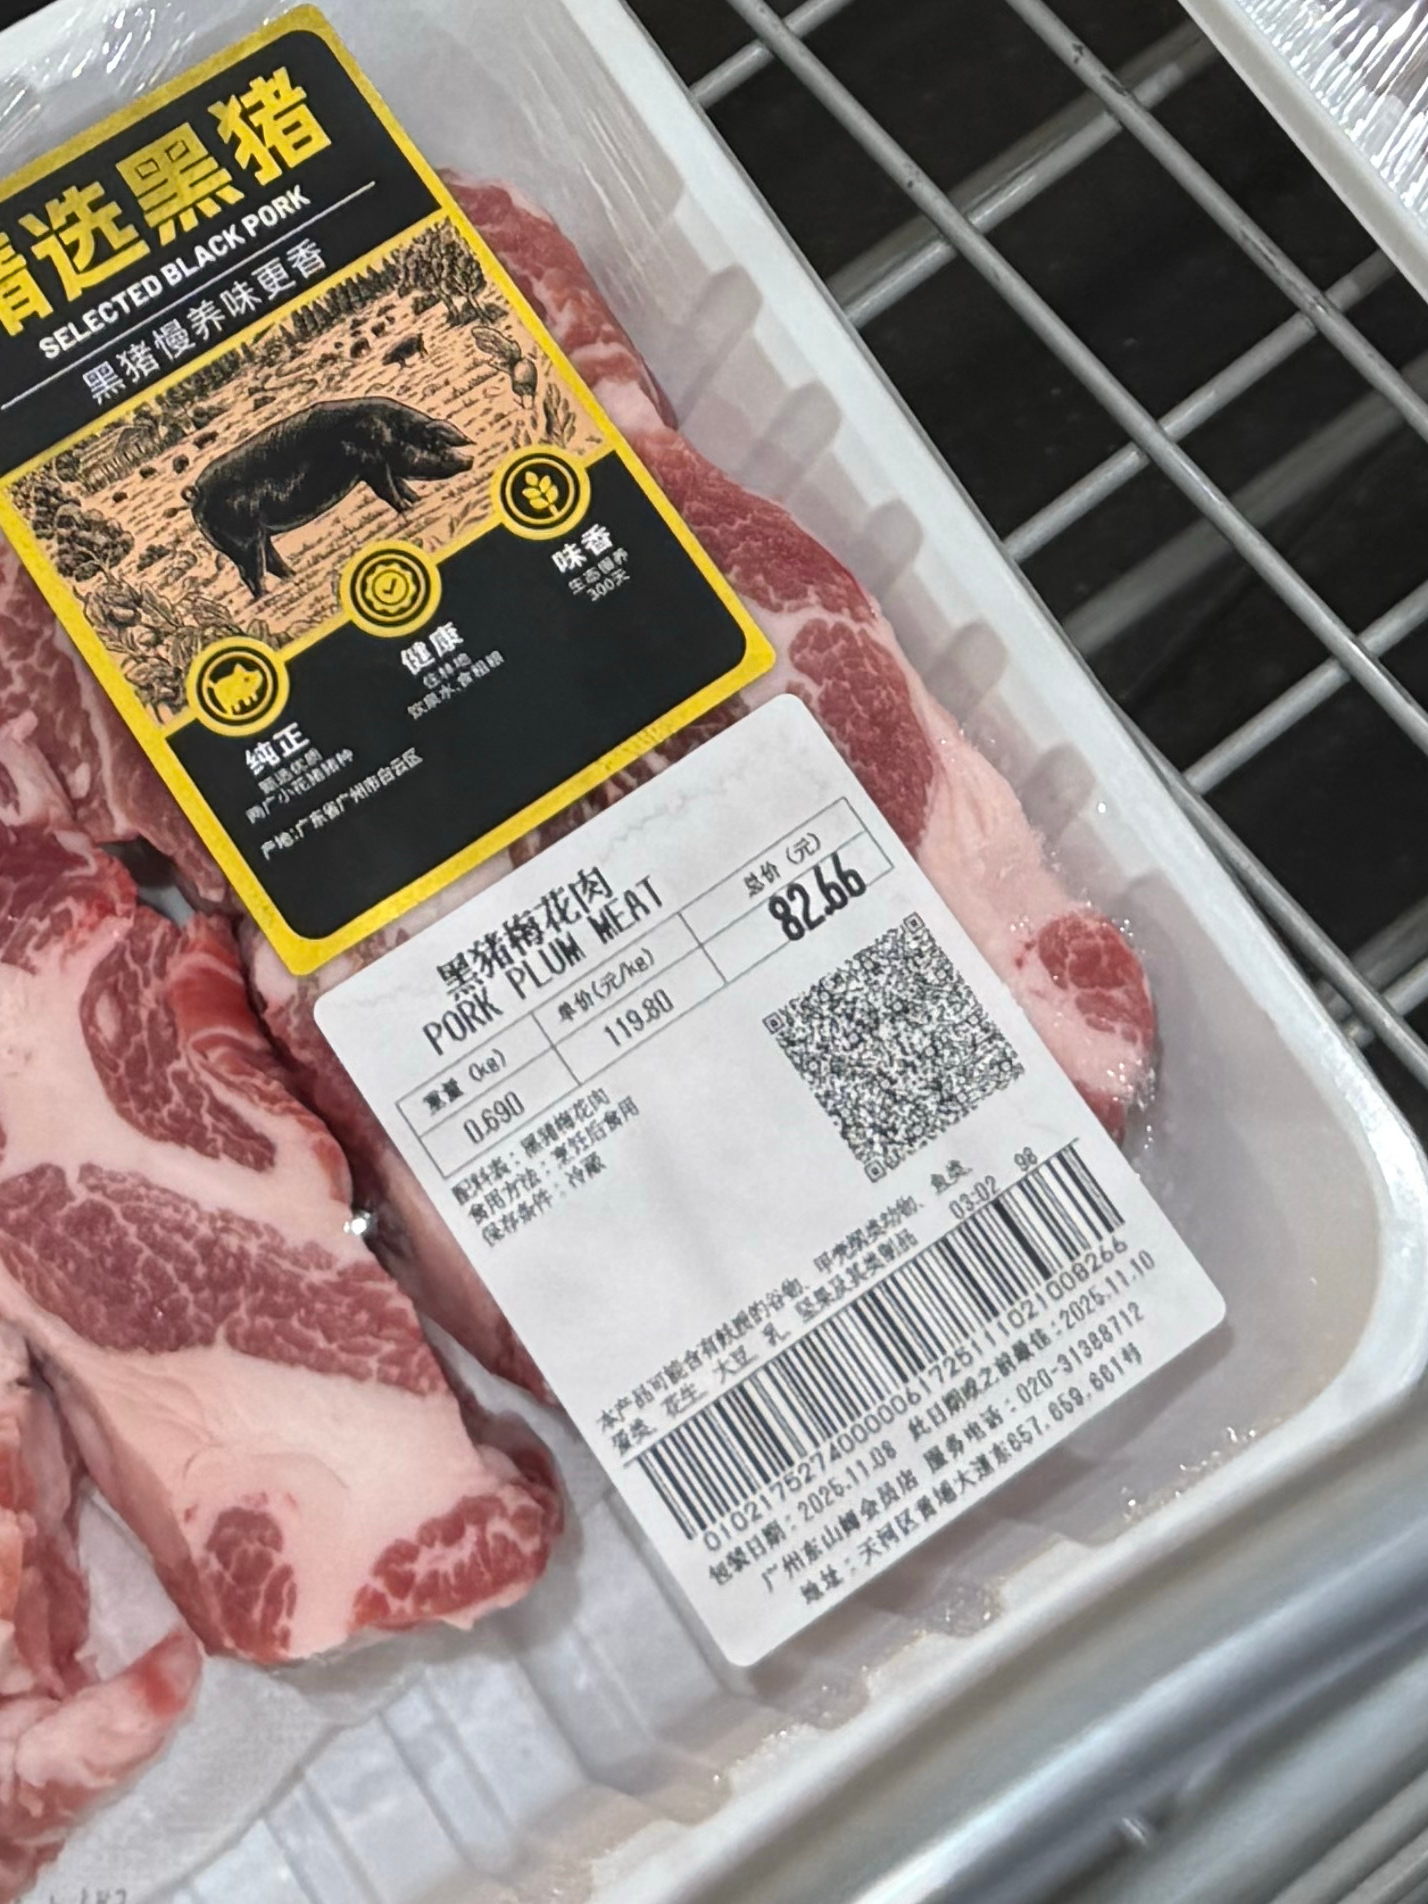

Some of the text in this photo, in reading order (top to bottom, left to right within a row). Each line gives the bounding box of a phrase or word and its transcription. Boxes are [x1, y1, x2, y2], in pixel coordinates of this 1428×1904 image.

[38, 183, 311, 359] SELECTED BLACK PORK
[81, 237, 326, 405] 黑猪慢养味更香
[550, 522, 613, 573] 味香
[585, 567, 630, 602] 300天
[399, 620, 464, 675] 健康
[244, 721, 310, 776] 纯正
[421, 874, 663, 1056] PORK PLUM MEAT
[435, 865, 619, 1002] 黑猪梅花肉
[462, 851, 867, 1145] 0.690 119.80 82.66
[947, 1174, 999, 1220] 03:02
[1012, 1145, 1038, 1172] 98
[700, 1234, 1129, 1552] 01021752740000061725111021008266
